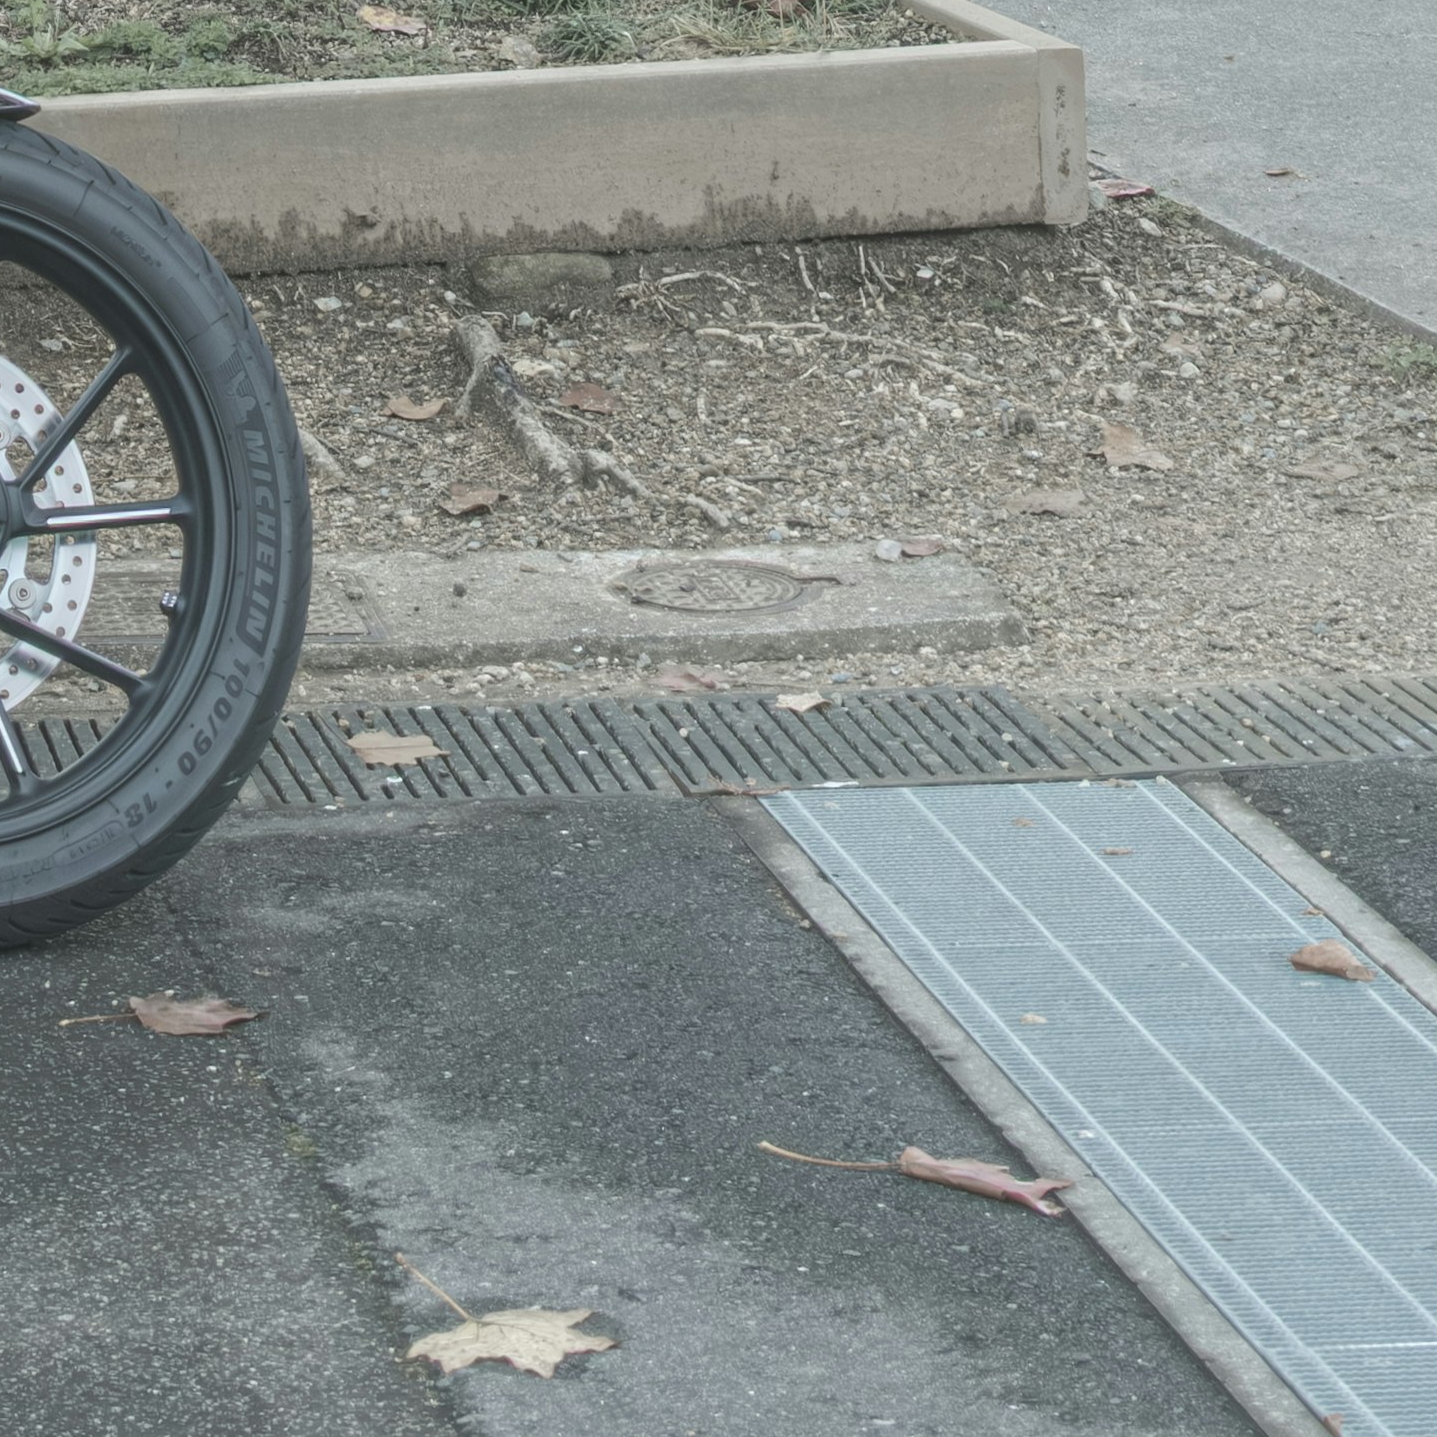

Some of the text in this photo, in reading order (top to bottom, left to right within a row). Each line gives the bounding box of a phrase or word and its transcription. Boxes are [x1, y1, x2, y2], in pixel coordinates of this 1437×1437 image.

[242, 429, 278, 644] MICHELIN
[175, 657, 252, 777] 100/90
[123, 794, 159, 830] 18
